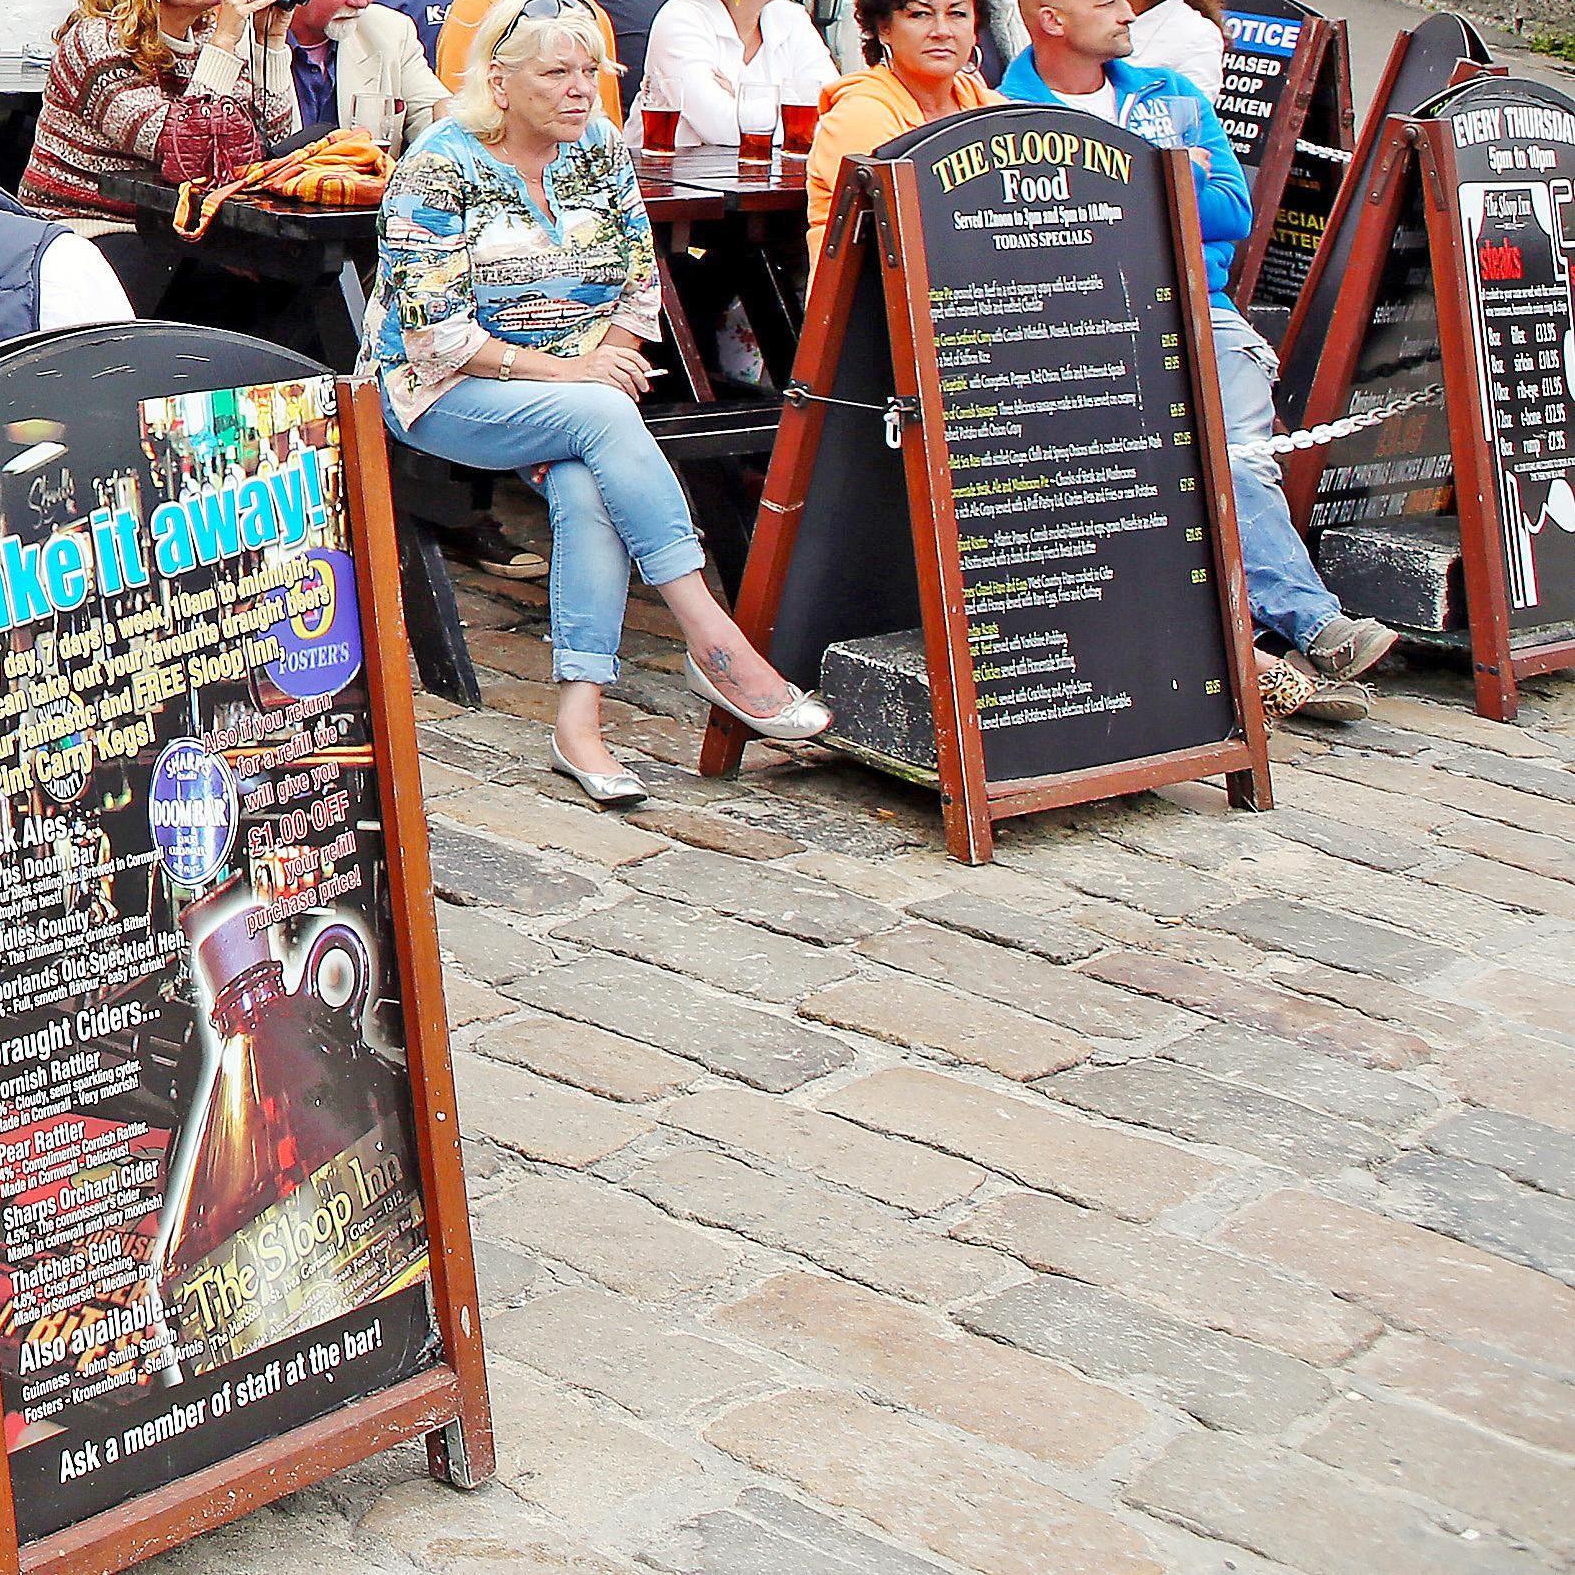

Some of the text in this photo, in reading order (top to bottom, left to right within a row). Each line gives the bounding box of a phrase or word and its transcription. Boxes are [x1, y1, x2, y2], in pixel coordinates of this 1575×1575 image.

[1226, 18, 1301, 49] OTICE
[1453, 106, 1501, 147] EVERY
[932, 130, 1133, 194] THE SLOOP INN
[1488, 145, 1555, 174] 5pm to 10pm
[1000, 167, 1070, 203] Food
[953, 210, 983, 229] Served
[984, 210, 1013, 227] 12noon
[1014, 211, 1023, 226] to
[1024, 208, 1042, 229] 3pm
[1043, 206, 1058, 224] and
[1060, 205, 1078, 227] 5pm
[1079, 206, 1088, 221] to
[993, 230, 1093, 249] TODAYS SPECIALS
[1480, 237, 1522, 279] steaks
[89, 502, 145, 596] it
[153, 448, 327, 578] away!
[35, 741, 95, 783] Carry
[96, 713, 156, 761] Kegs!
[249, 790, 349, 857] £1.00 OFF
[59, 1318, 383, 1484] Ask a member of staff at the bar!
